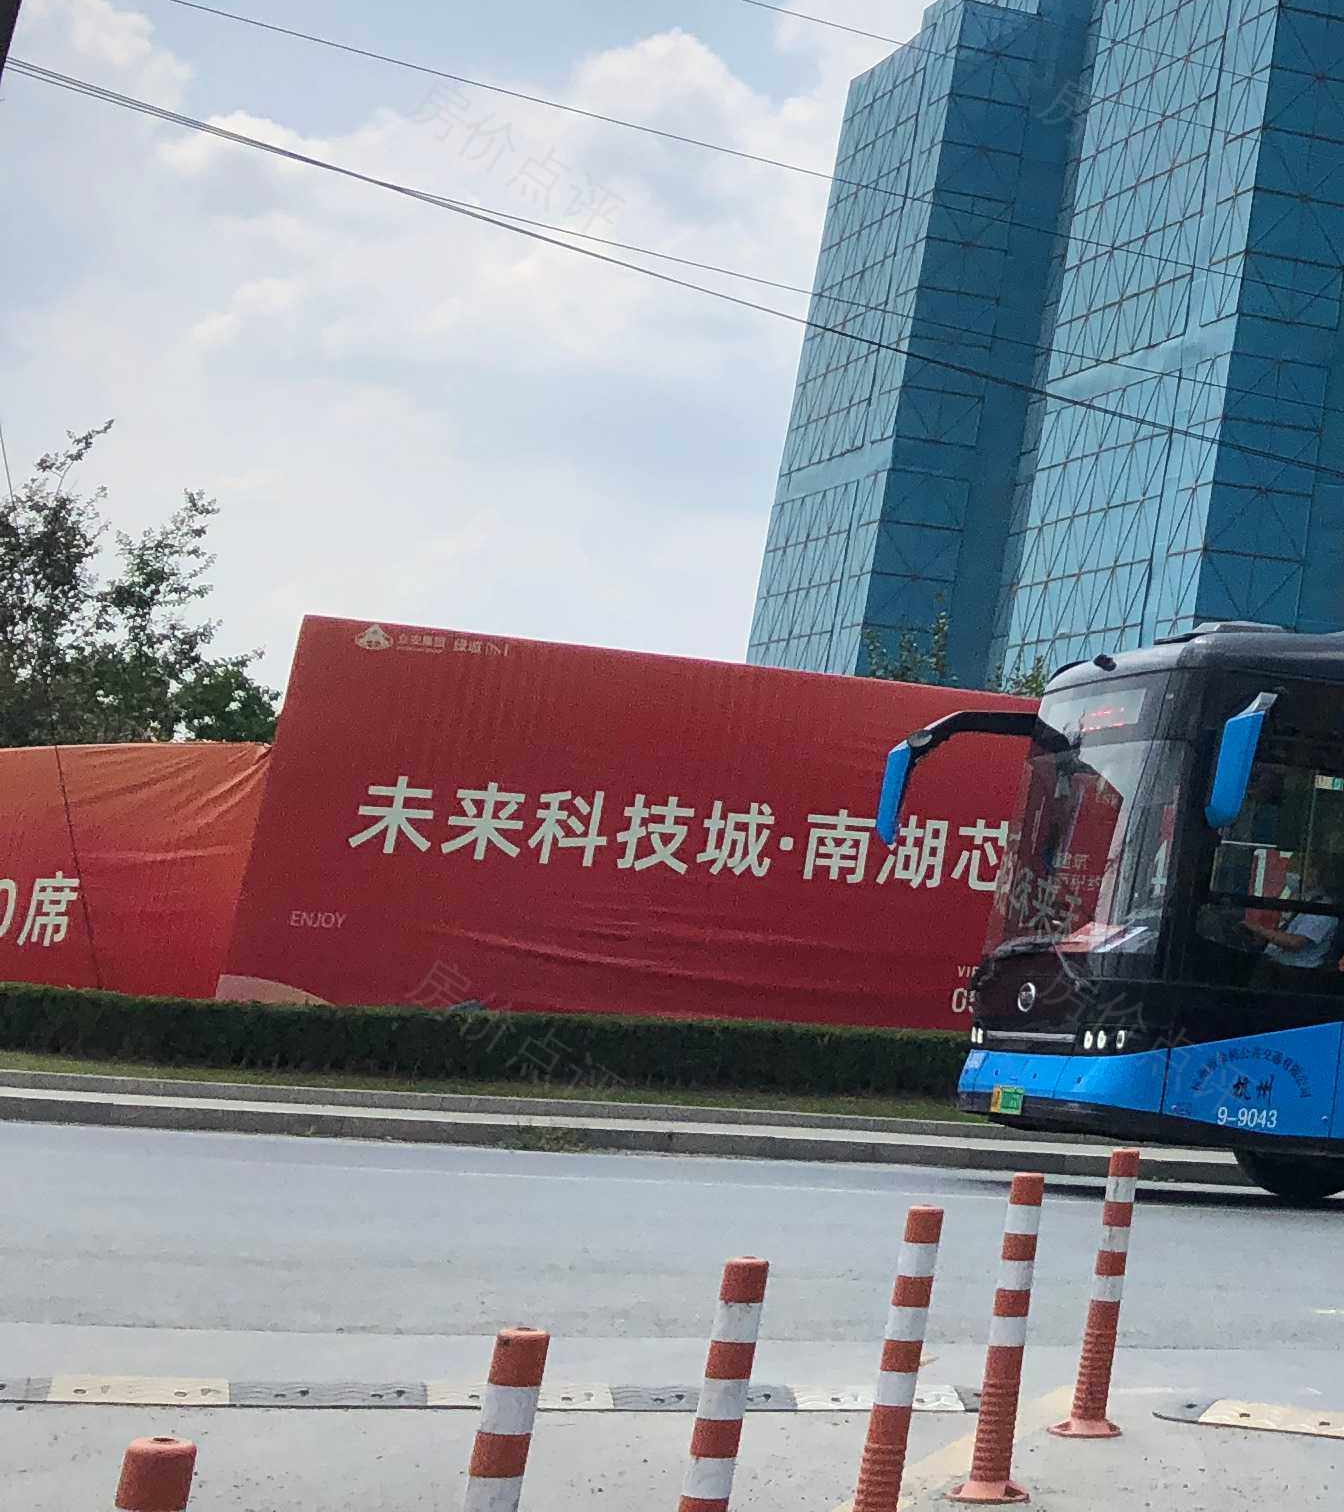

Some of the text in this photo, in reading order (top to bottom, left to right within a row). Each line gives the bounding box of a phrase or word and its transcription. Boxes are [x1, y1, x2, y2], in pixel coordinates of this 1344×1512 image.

[348, 773, 1010, 894] 未来科技城·南湖芯
[289, 909, 348, 929] ENJOY
[1216, 1105, 1279, 1129] 9-9043
